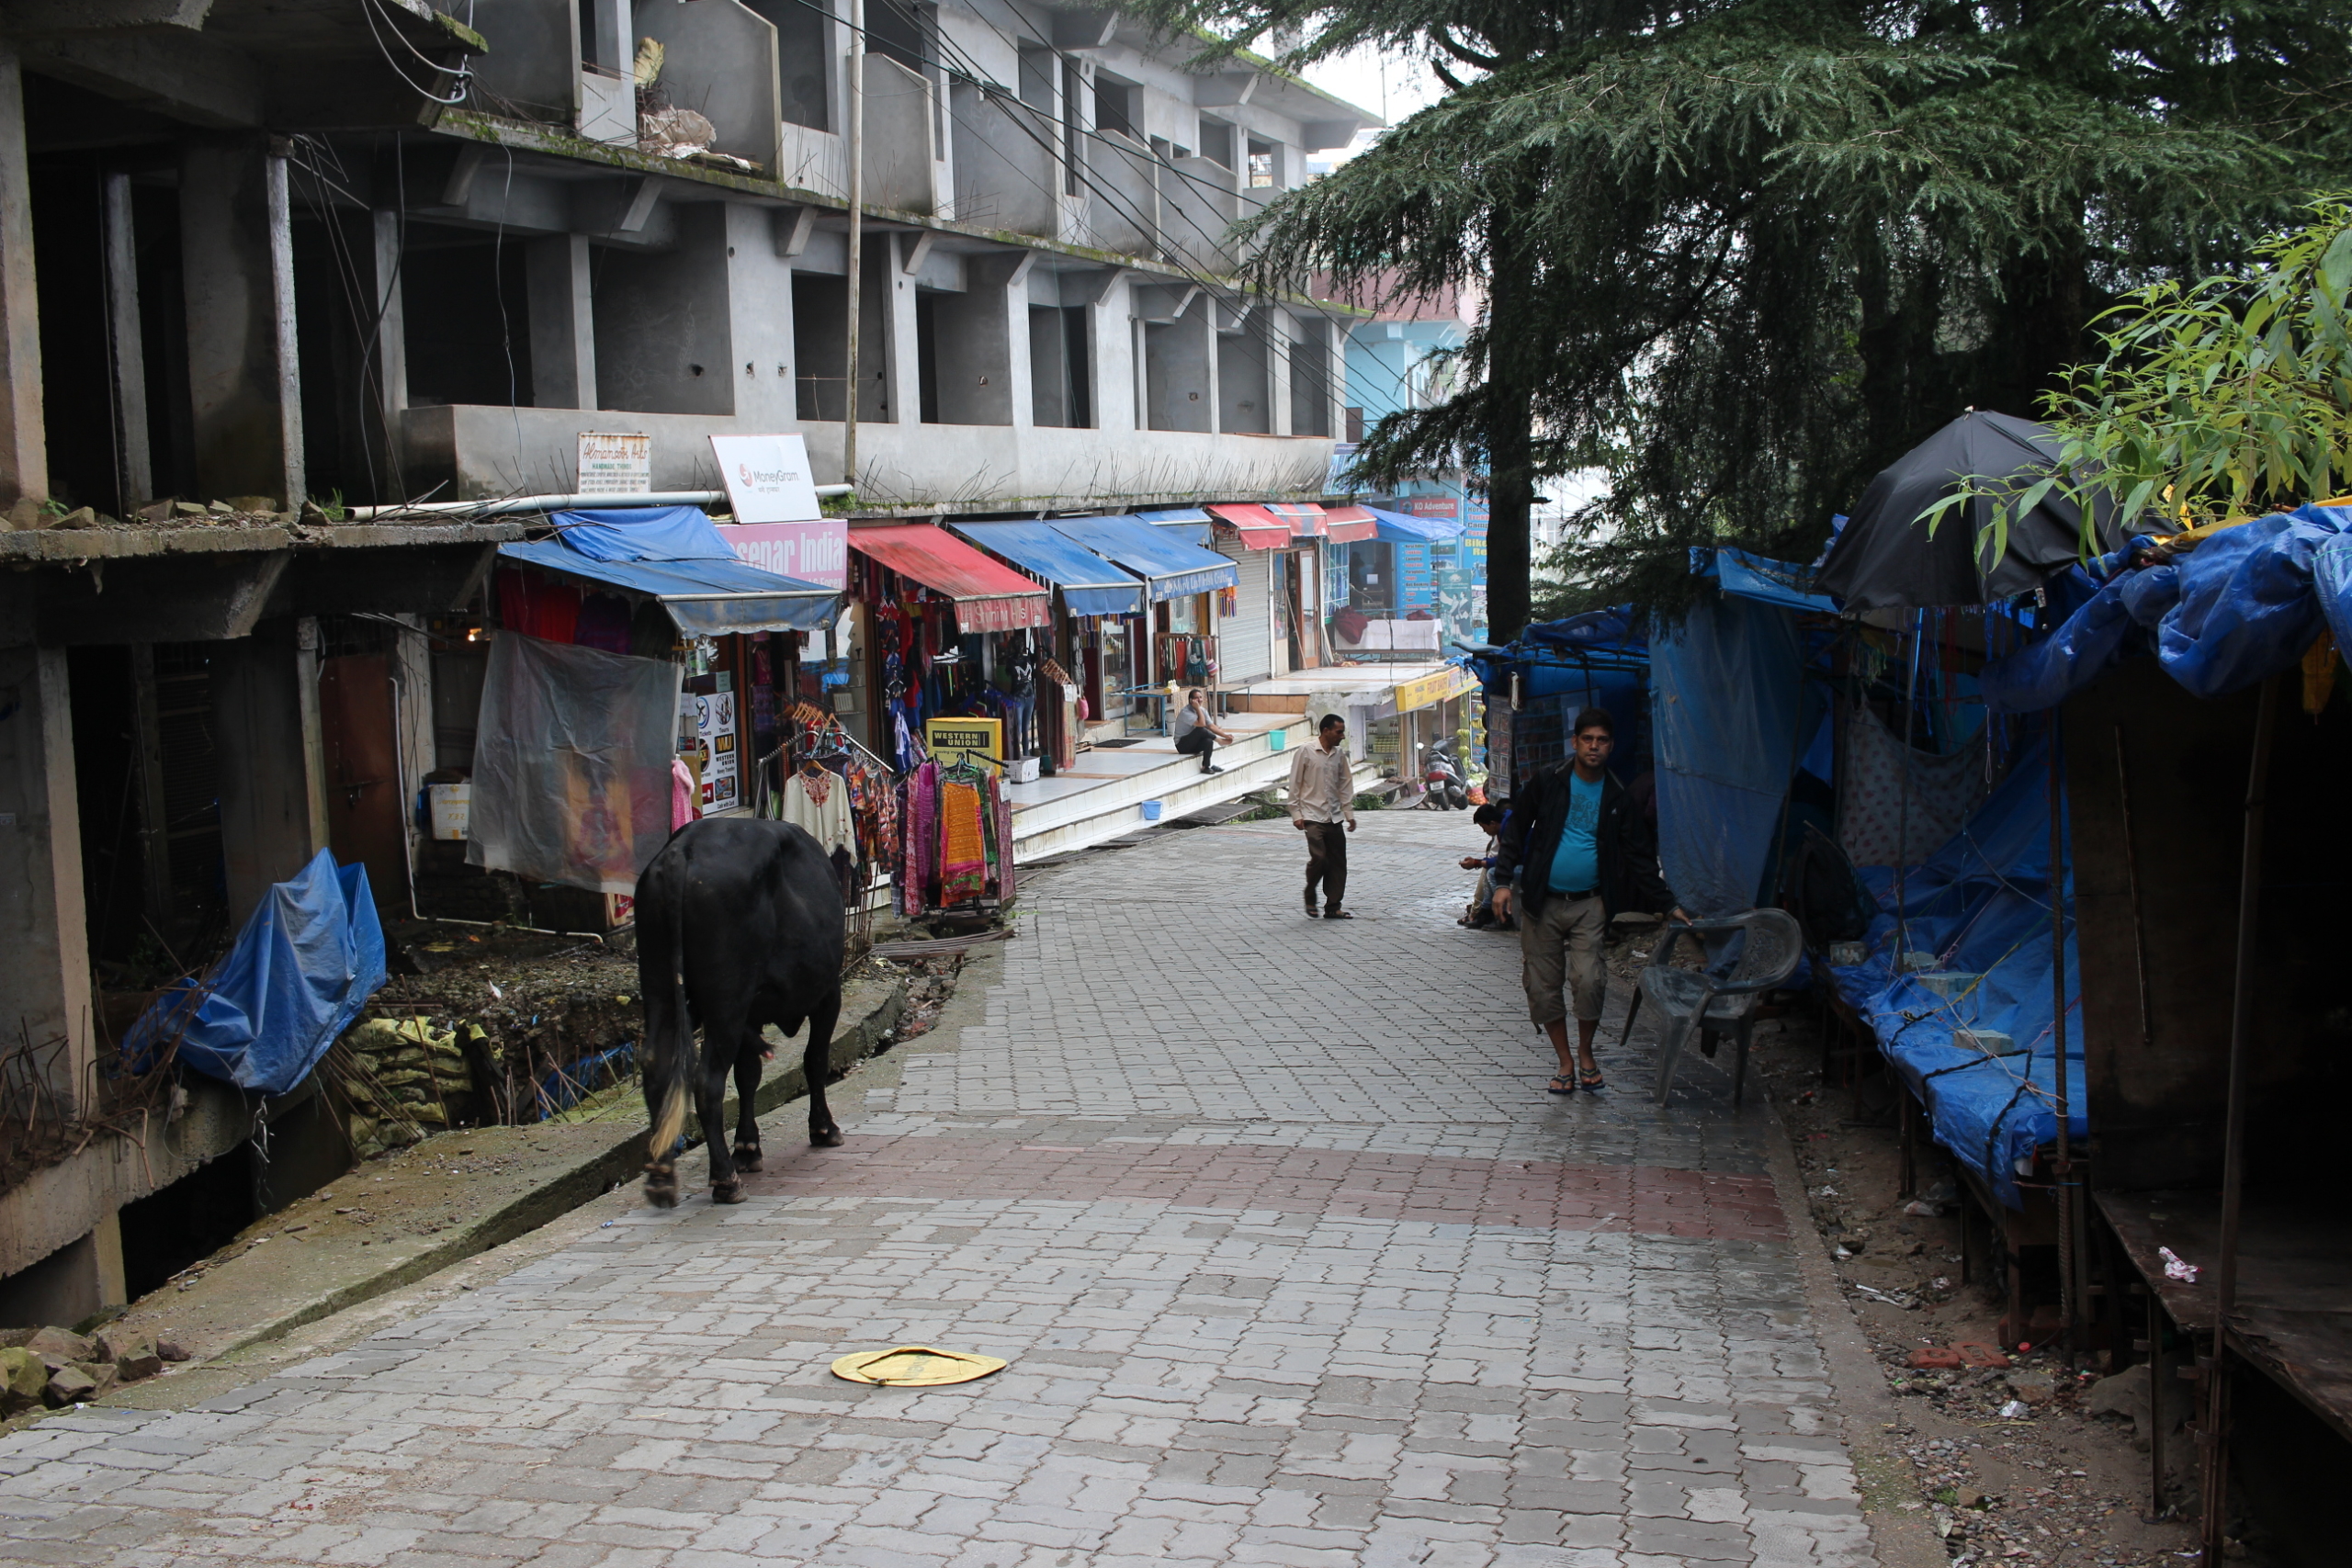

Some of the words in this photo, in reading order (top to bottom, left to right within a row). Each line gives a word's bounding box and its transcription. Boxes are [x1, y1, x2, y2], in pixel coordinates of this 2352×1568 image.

[631, 443, 648, 459] Arts
[753, 469, 799, 485] MoneyGram
[1424, 502, 1454, 511] Adventure
[800, 531, 843, 573] India
[947, 739, 978, 747] UNION
[716, 753, 735, 761] WESTERN
